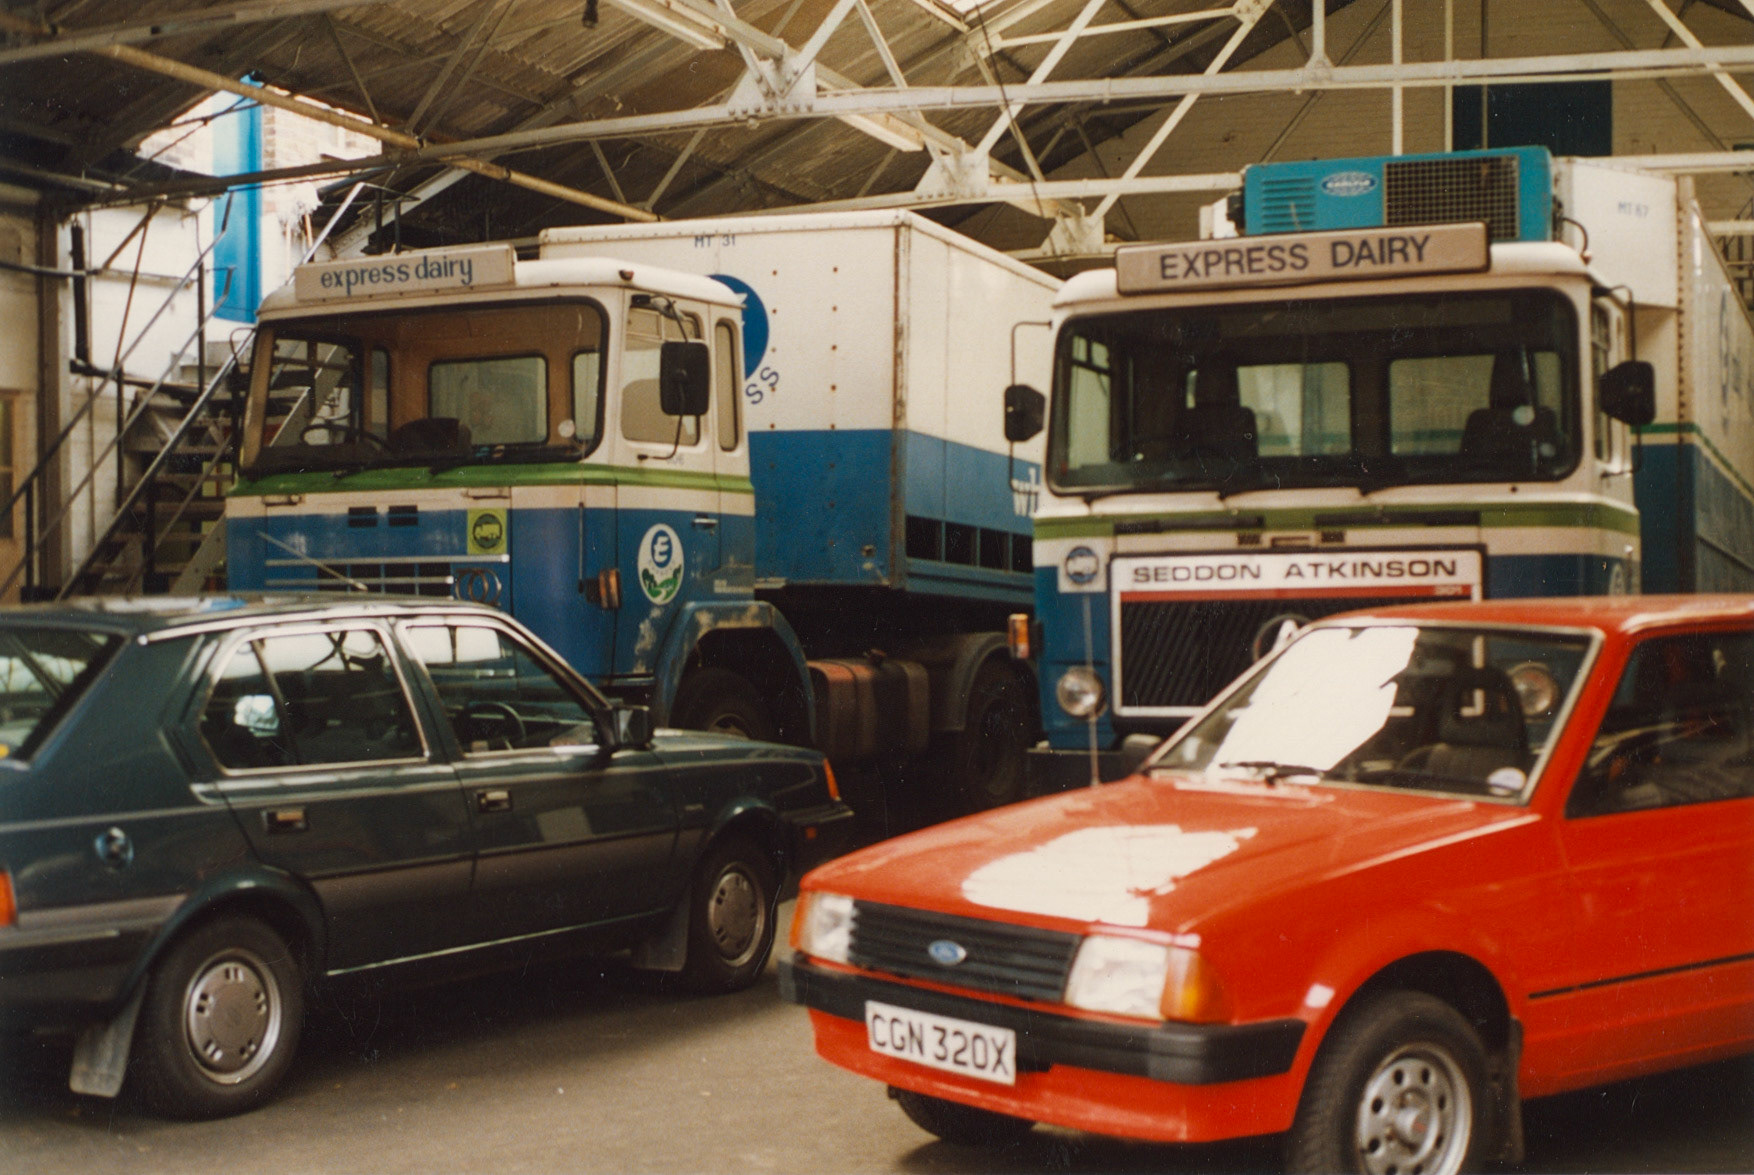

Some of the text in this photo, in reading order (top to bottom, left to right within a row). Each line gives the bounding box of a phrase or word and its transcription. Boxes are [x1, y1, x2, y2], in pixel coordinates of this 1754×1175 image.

[694, 234, 736, 247] MT 31
[1159, 234, 1430, 280] EXPRESS DAIRY
[320, 254, 473, 296] express dairy
[1132, 559, 1457, 583] SEDDON ATKINSON
[871, 1012, 1010, 1076] CGN 320X
